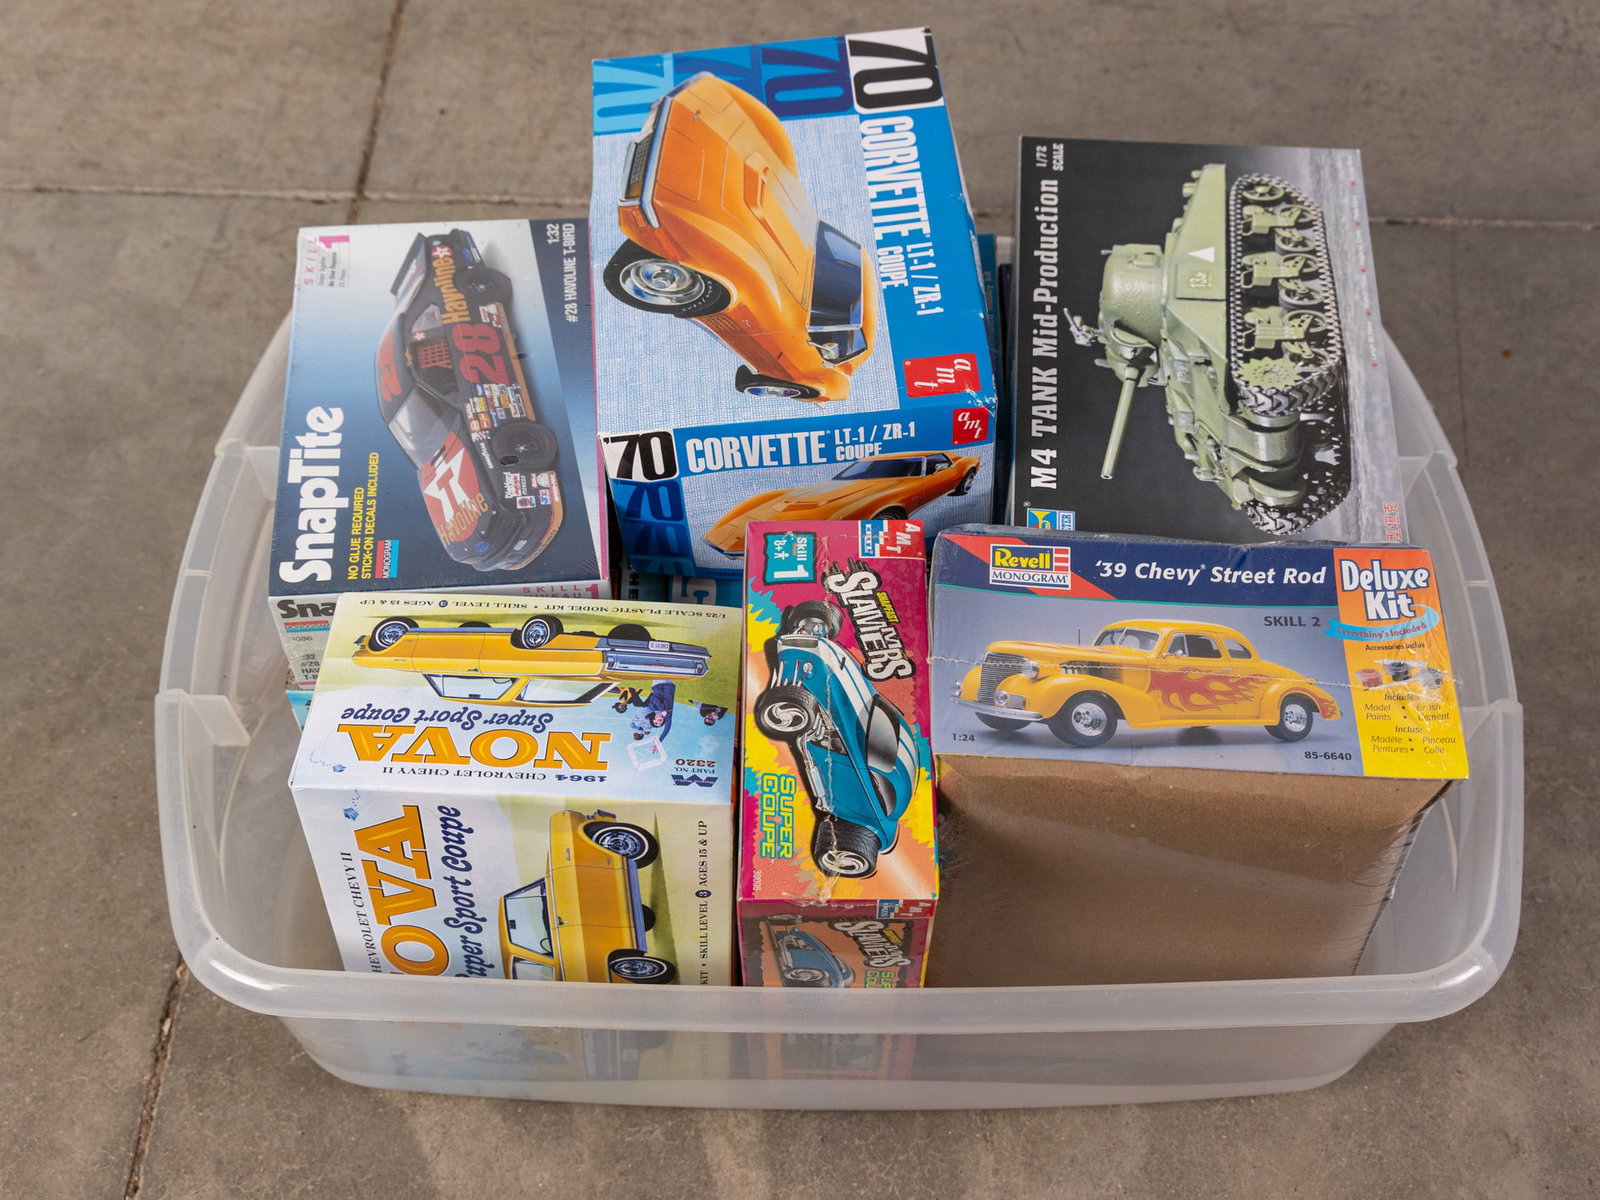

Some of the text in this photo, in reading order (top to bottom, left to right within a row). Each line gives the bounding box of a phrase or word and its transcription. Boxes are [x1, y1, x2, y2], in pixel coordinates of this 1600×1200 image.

[1036, 145, 1047, 168] 1/72
[1053, 143, 1064, 171] SCALE
[860, 115, 931, 240] CORVETTE
[546, 223, 560, 245] 1:32
[877, 246, 908, 289] COUPE
[906, 242, 936, 270] LT-1
[562, 223, 579, 323] #28 HAVOLINE T-BIRD
[432, 256, 471, 325] Havoline
[913, 283, 944, 315] ZR-1
[1030, 179, 1059, 490] M4 TANK Mid-Production
[452, 323, 510, 385] 28
[834, 428, 865, 446] LT-1
[883, 421, 916, 441] ZR-1
[686, 432, 826, 473] CORVETTE
[836, 442, 882, 461] COUPE
[279, 406, 350, 584] SnapTite
[361, 452, 379, 579] STICK-ON DECALS INCLUDED
[347, 487, 365, 580] NO GLUE REQUIRED
[886, 522, 921, 554] AMT
[382, 539, 392, 579] MONOGRAM
[797, 536, 807, 561] Skill
[994, 548, 1051, 569] Revell
[992, 571, 1068, 584] MONOGRAM
[1095, 560, 1326, 585] '39 Chevy Street Rod
[1340, 560, 1430, 591] Deluxe
[522, 584, 581, 593] SKILL
[453, 600, 490, 608] LEVEL
[544, 603, 564, 611] KIT
[567, 604, 609, 612] MODEL
[612, 606, 661, 616] PLASTIC
[665, 609, 703, 618] SCALE
[705, 611, 726, 620] 1/25
[876, 591, 899, 623] SNAPFAST
[1364, 591, 1416, 620] Kit
[1264, 616, 1321, 627] SKILL 2
[1337, 622, 1428, 639] Everything's Included
[341, 703, 553, 734] Super Sport Coupe
[1365, 703, 1391, 711] Model
[1366, 713, 1391, 721] Paints
[337, 724, 611, 770] NOVA
[952, 732, 976, 743] 1:24
[675, 758, 716, 768] 2320
[1304, 751, 1352, 761] 85-6640
[398, 767, 450, 777] CHEVY
[453, 769, 546, 781] CHEVROLET
[555, 773, 607, 783] 1964
[698, 820, 708, 836] UP
[761, 775, 779, 858] COUPE
[779, 777, 795, 858] SUPER
[437, 805, 475, 872] Coupe
[698, 838, 708, 846] &
[699, 848, 708, 858] 15
[698, 860, 709, 887] AGES
[344, 865, 365, 908] CHEVY
[354, 805, 450, 976] OVA
[443, 876, 487, 934] Sport
[699, 900, 709, 932] LEVEL
[356, 911, 382, 973] HEVROLET
[700, 933, 709, 959] SKILL
[701, 970, 709, 985] KIT
[880, 970, 896, 988] SUP
